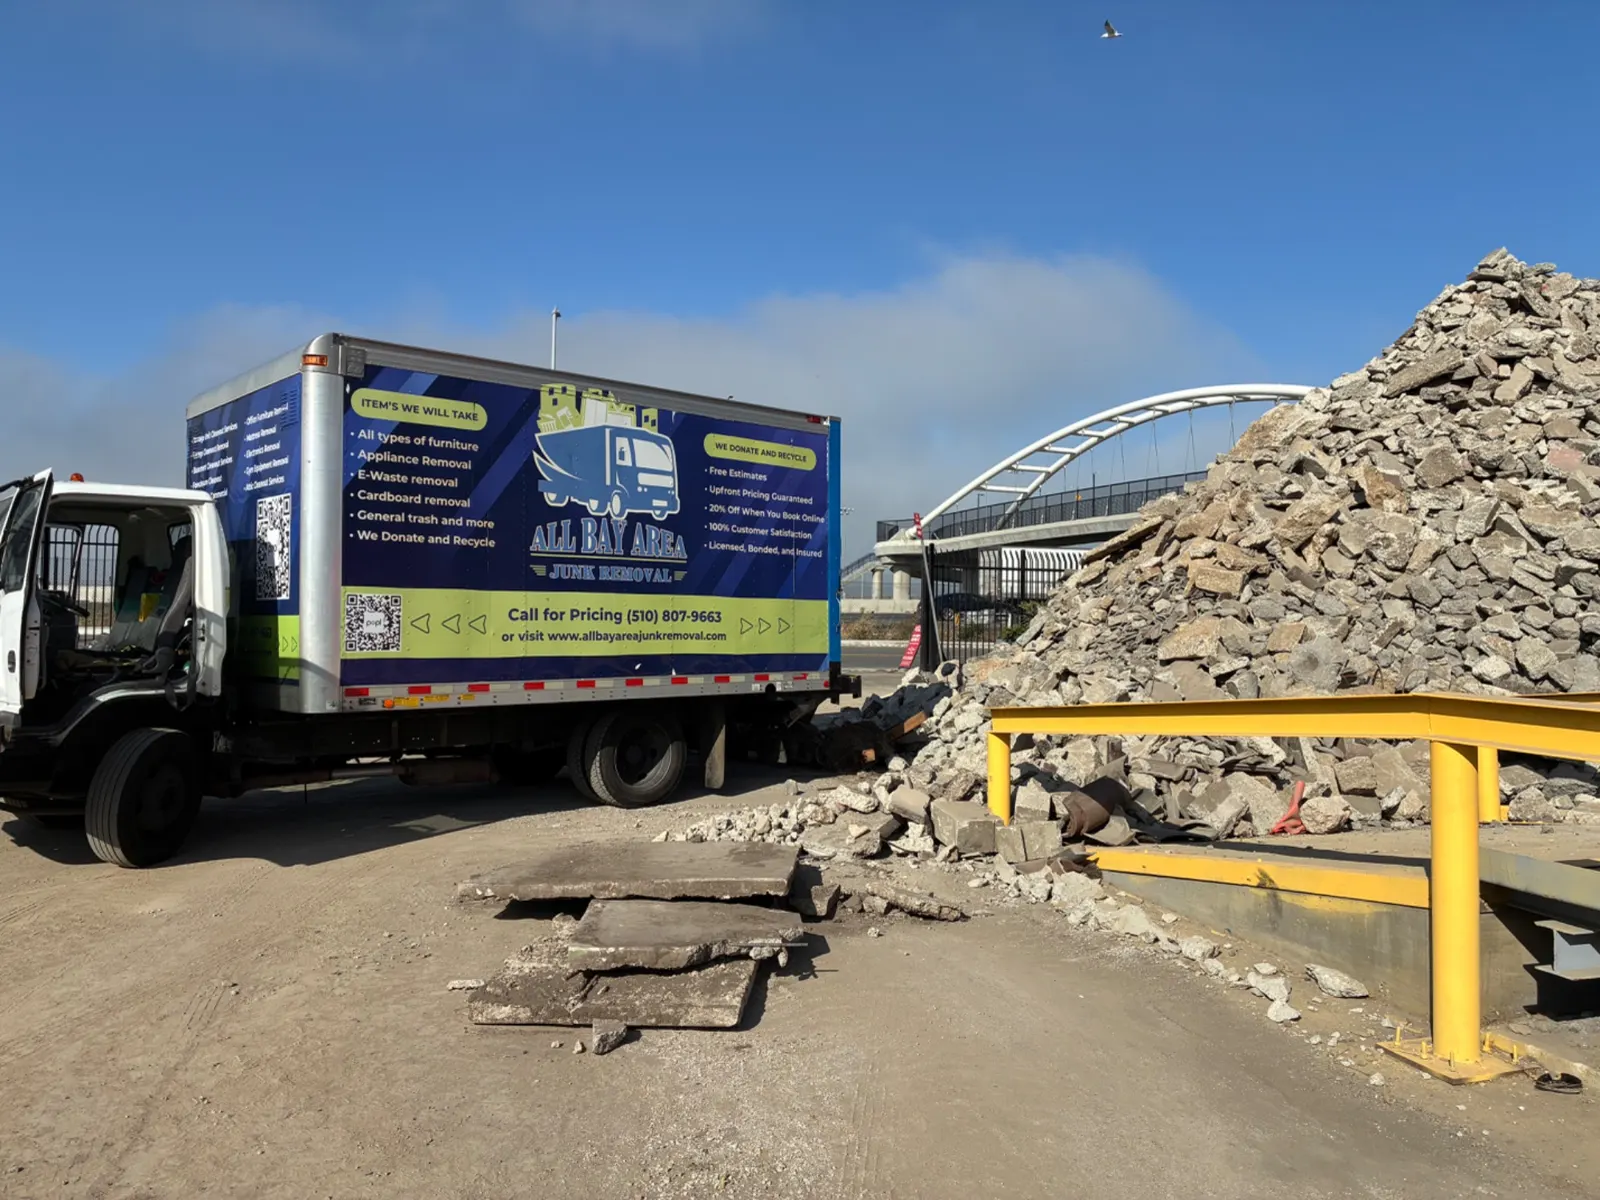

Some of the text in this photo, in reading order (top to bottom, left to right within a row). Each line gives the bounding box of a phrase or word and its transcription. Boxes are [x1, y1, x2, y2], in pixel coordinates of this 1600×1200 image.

[361, 398, 478, 421] ITEM'S WE WILL TAKE
[358, 429, 479, 452] All types of furniture
[358, 448, 472, 470] Appliance Removal
[730, 444, 759, 456] DONATE
[761, 449, 776, 458] AND
[778, 452, 807, 462] RECYCLE
[358, 470, 458, 488] E-Waste removal
[710, 466, 767, 481] Free Estimates
[358, 490, 471, 508] Cardboard removal
[710, 485, 813, 505] Upfront Pricing Guaranteed
[357, 510, 495, 528] General trash and more
[709, 504, 825, 523] 20% Off When You Book Online
[358, 530, 496, 548] We Donate and Recycle
[530, 517, 688, 560] ALL BAY AREA
[709, 523, 812, 539] 100% Customer Satisfaction
[709, 541, 822, 558] Licensed, Bonded, and Insured
[549, 564, 672, 583] JUNK REMOVAL
[508, 608, 722, 625] Call for Pricing (510) 807-9663
[501, 630, 727, 643] or visit www.allbayareajunkremoval.com
